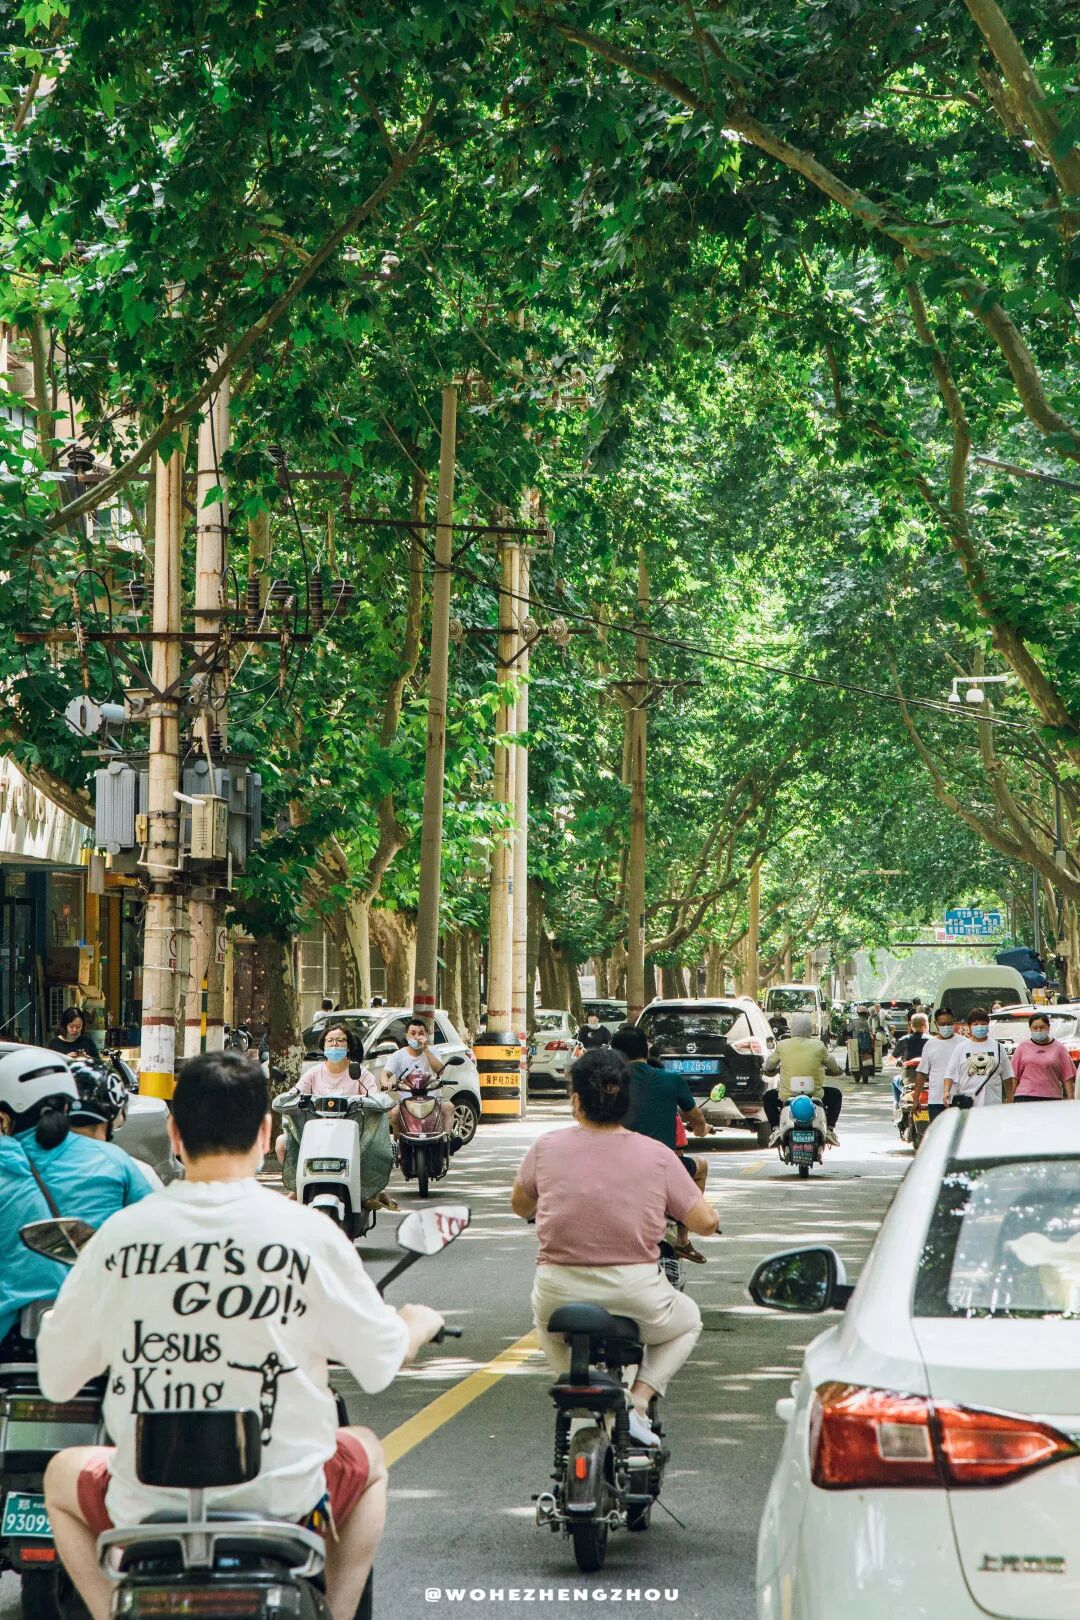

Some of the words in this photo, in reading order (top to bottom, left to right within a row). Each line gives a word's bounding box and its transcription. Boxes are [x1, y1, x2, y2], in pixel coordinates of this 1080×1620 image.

[257, 1243, 311, 1285] ON
[173, 1280, 307, 1324] GOD!"
[122, 1319, 221, 1363] Jesus
[130, 1367, 225, 1414] King
